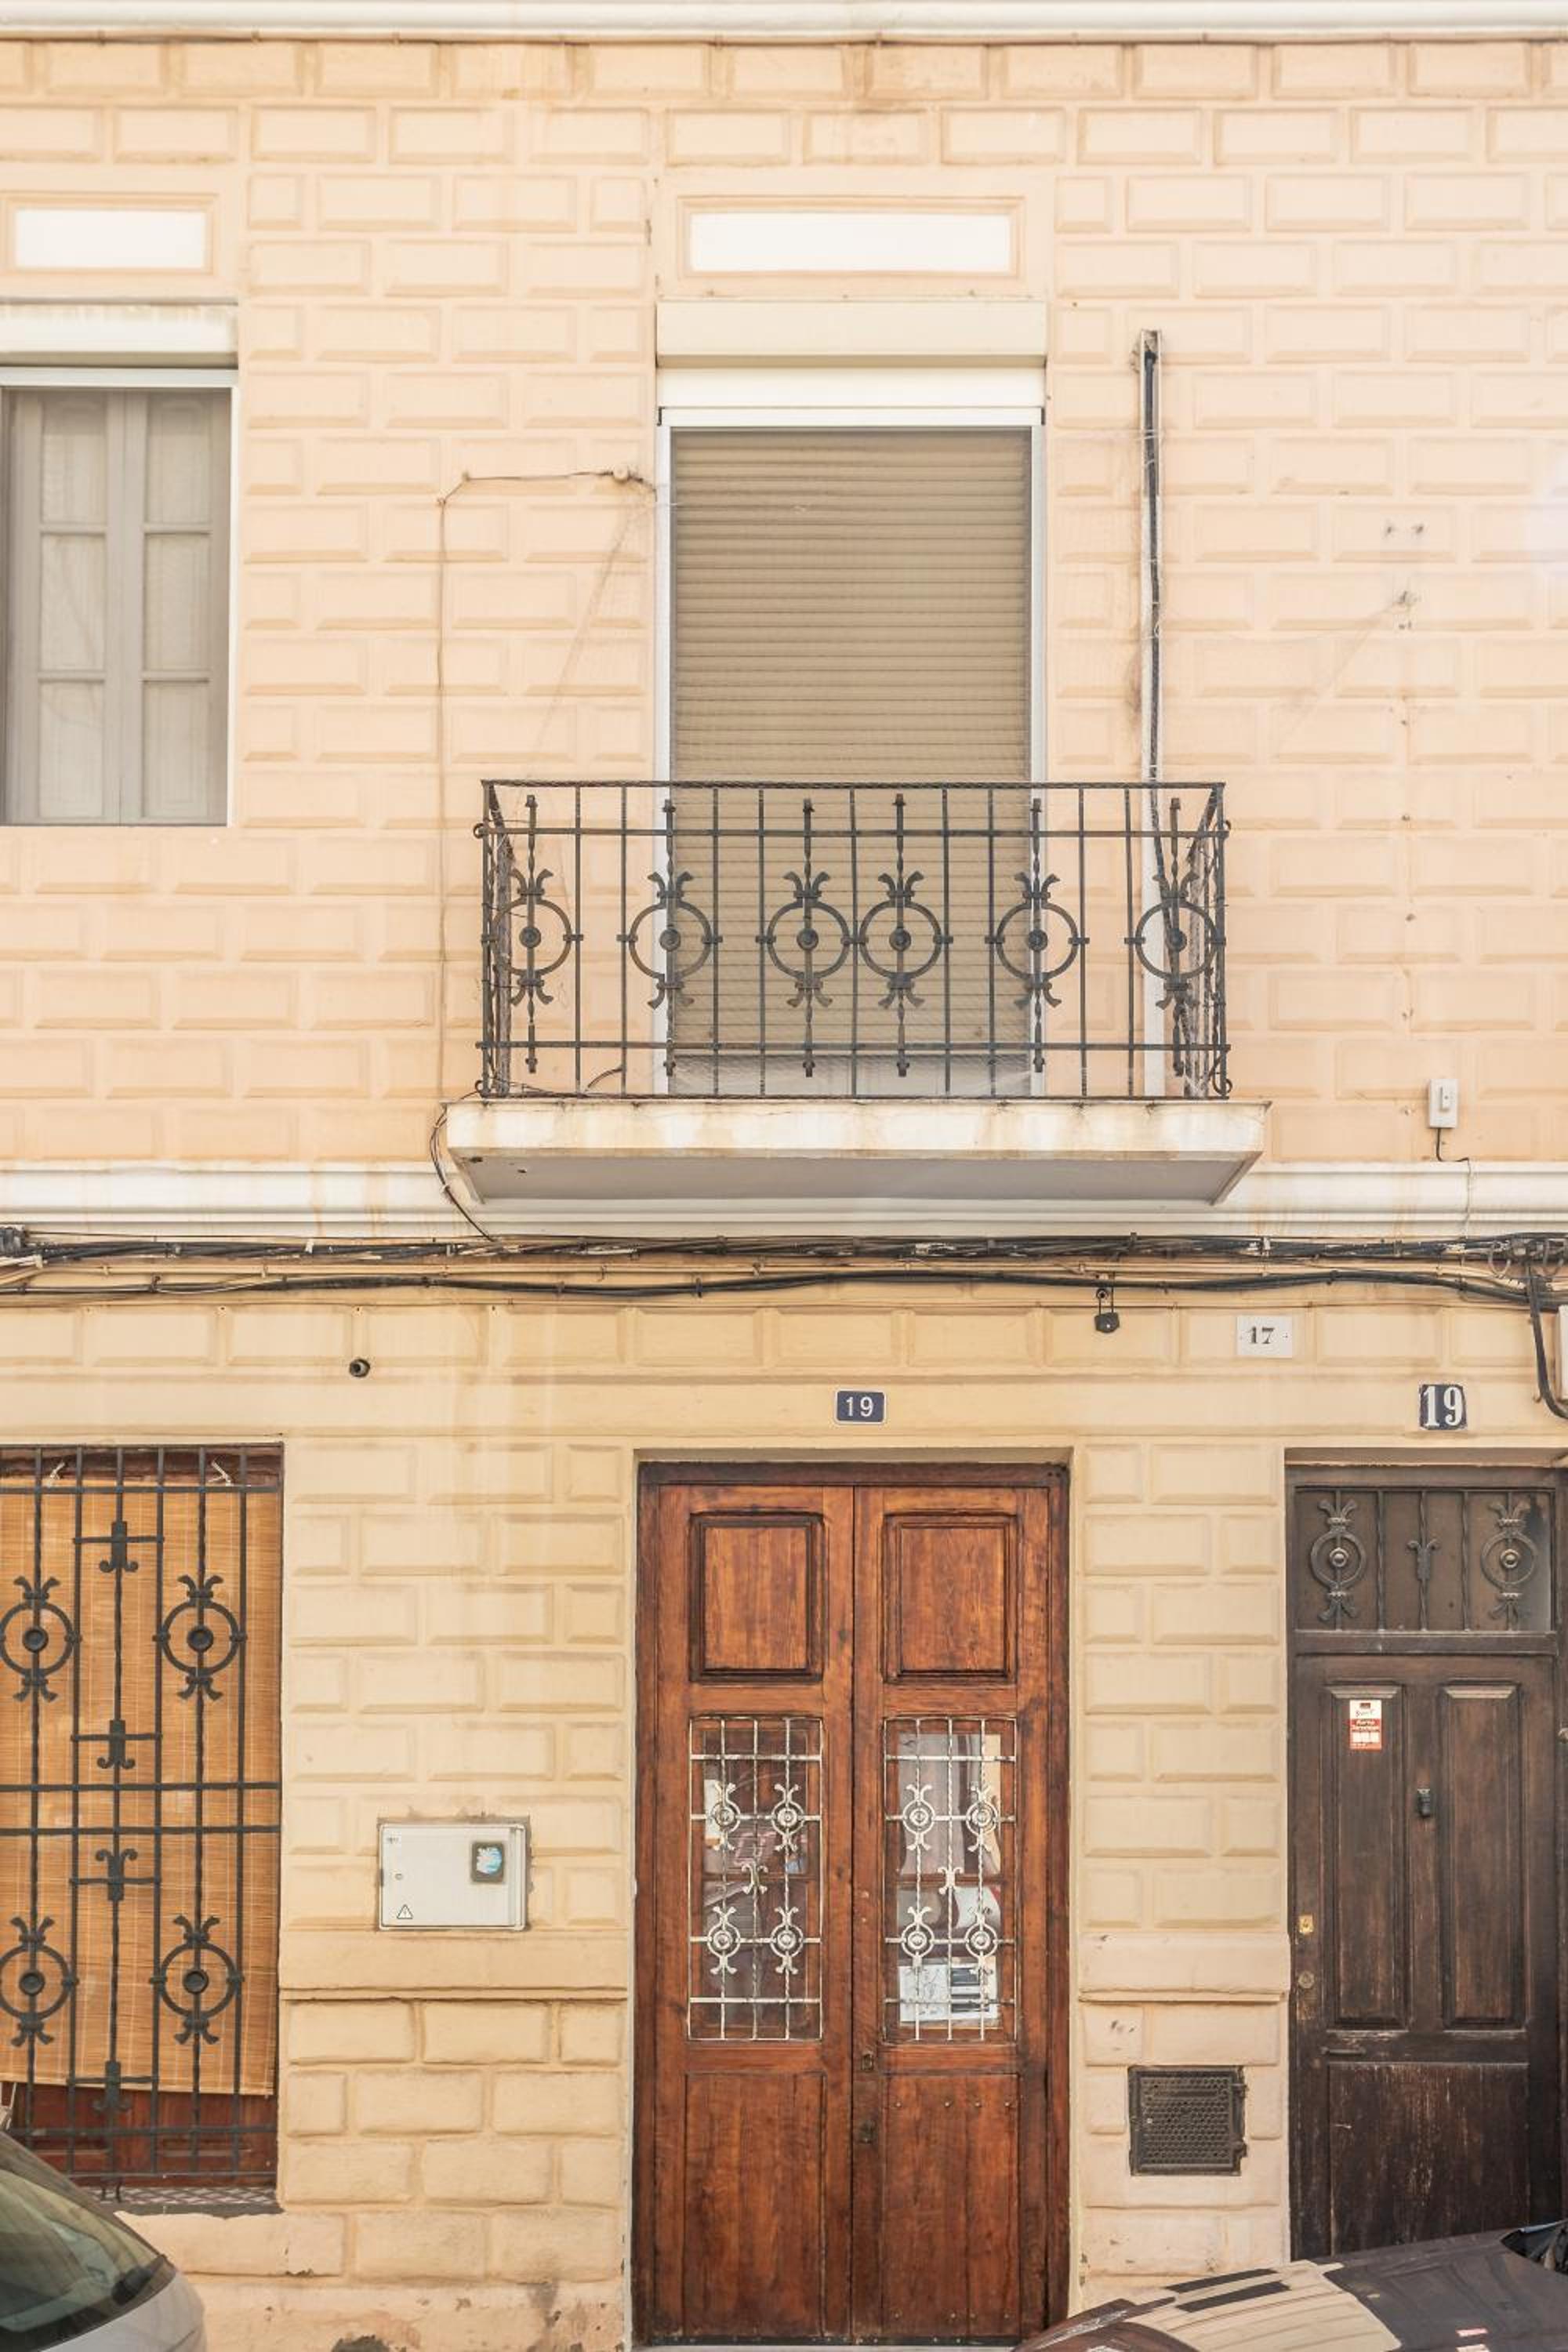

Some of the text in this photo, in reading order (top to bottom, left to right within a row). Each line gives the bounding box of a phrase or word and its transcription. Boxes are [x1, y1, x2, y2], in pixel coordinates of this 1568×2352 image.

[1250, 1326, 1275, 1345] 17
[846, 1396, 873, 1417] 19
[1422, 1385, 1463, 1427] 19
